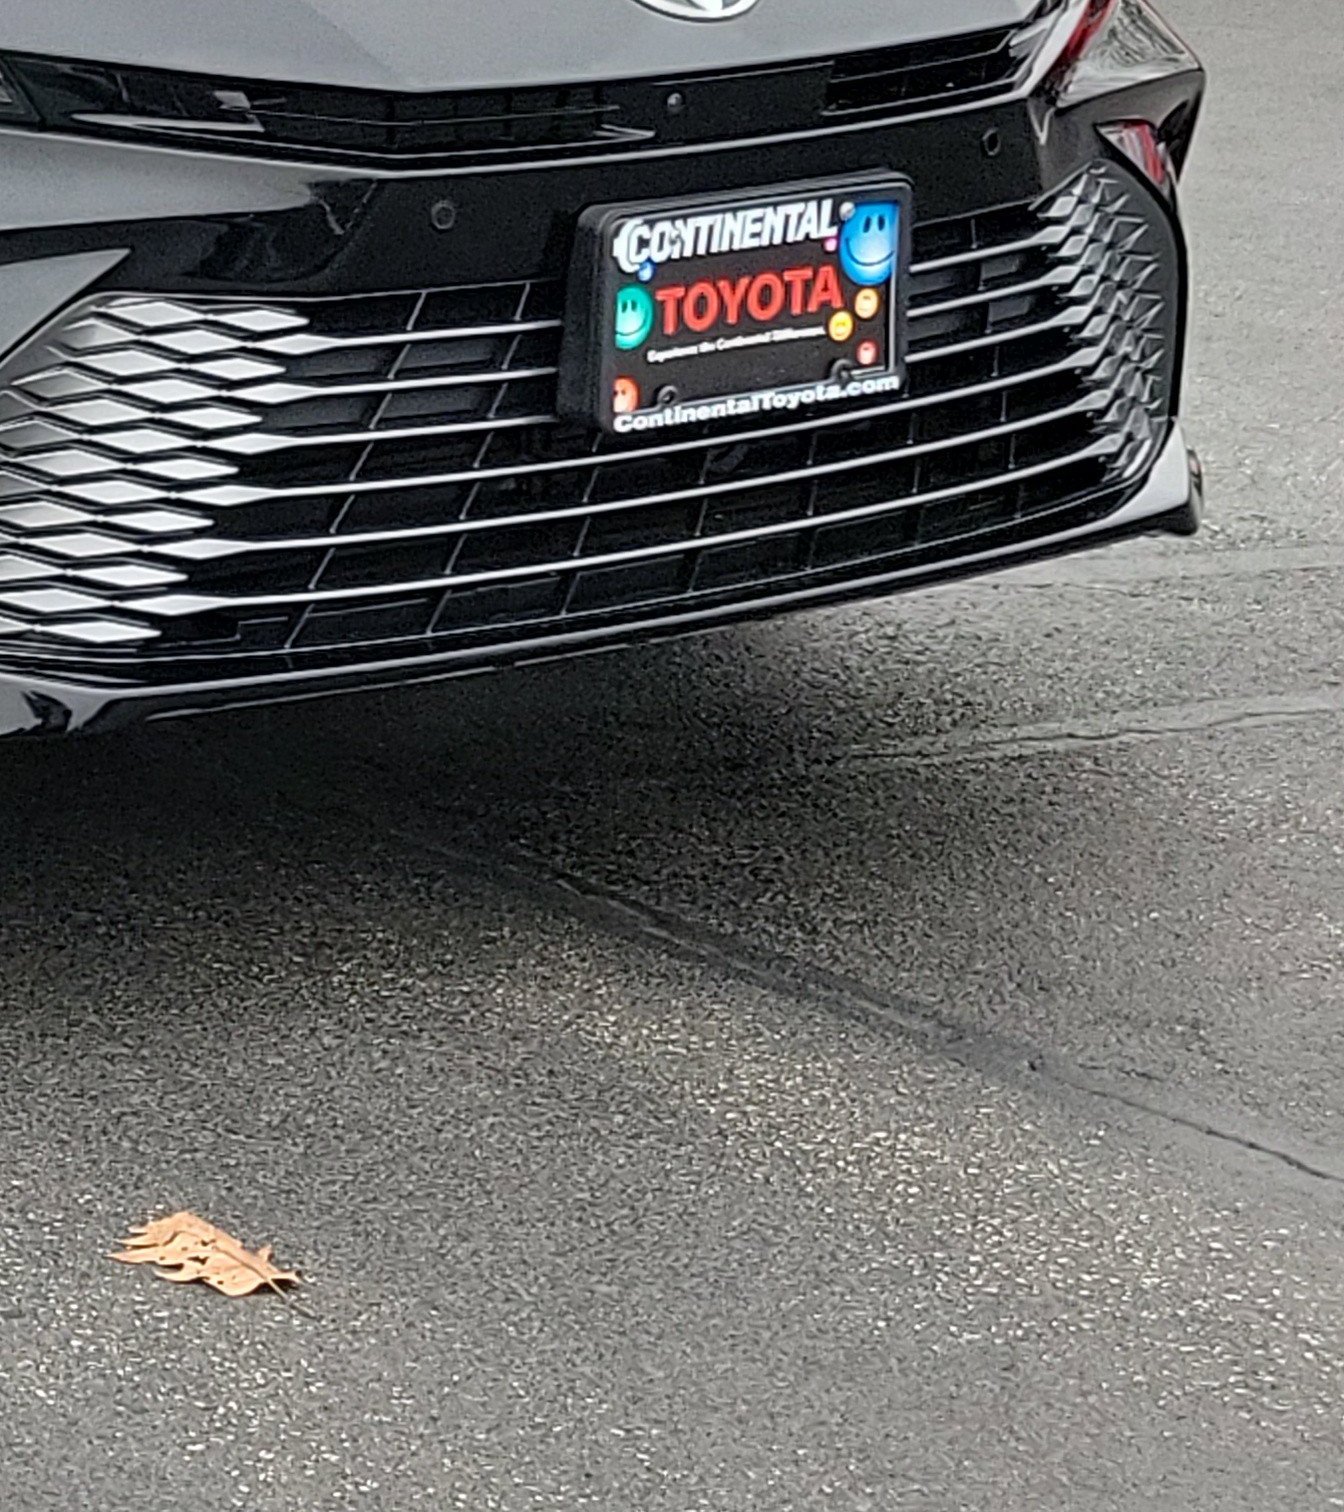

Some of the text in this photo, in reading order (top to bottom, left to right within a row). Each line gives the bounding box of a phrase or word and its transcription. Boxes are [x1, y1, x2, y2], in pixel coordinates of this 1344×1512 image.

[613, 199, 838, 274] CONTINENTAL
[655, 264, 845, 336] TOYOTA
[613, 375, 900, 433] ContinentalToyota.com
